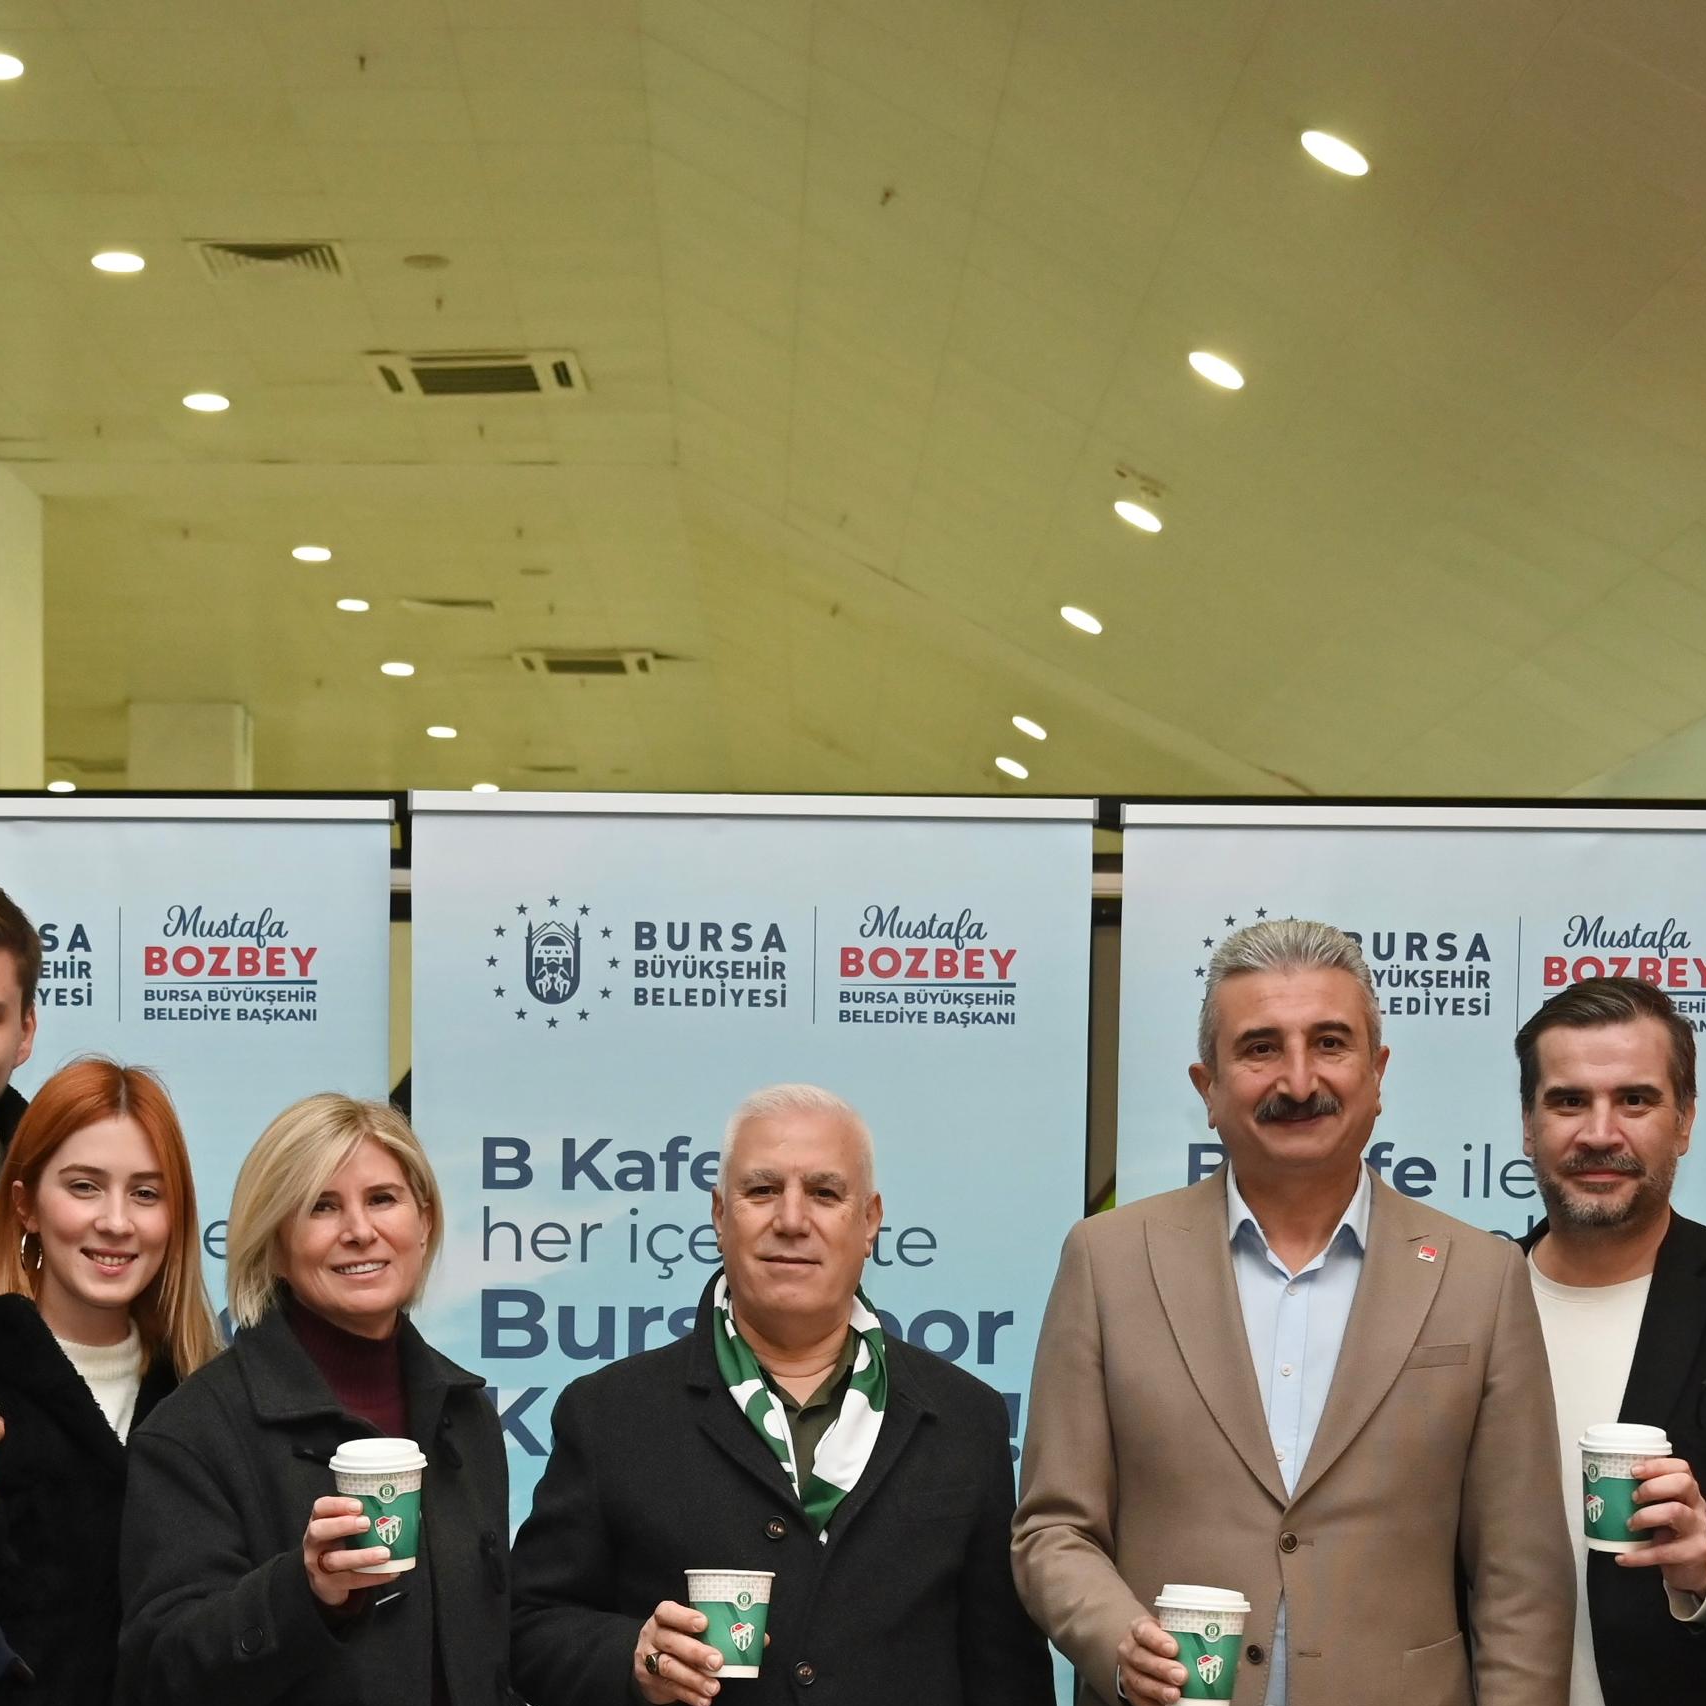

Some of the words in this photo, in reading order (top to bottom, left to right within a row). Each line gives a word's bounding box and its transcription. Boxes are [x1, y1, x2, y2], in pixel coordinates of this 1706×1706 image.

[162, 904, 290, 949] Mustafa
[634, 921, 787, 953] BURSA
[859, 904, 988, 950] Mustafa
[1563, 914, 1691, 960] Mustafa
[144, 945, 318, 977] BOZBEY
[634, 954, 787, 983] BÜYÜKŞEHİR
[840, 946, 1017, 980] BOZBEY
[1367, 964, 1491, 992] YÜKŞEHİR
[144, 989, 202, 1003] BURSA
[207, 986, 317, 1006] BÜYÜKŞEHİR
[634, 982, 787, 1008] BELEDİYESİ
[839, 990, 899, 1004] BURSA
[904, 989, 1016, 1009] BÜYÜKŞEHİR
[144, 1004, 231, 1021] BELEDİYE
[236, 1008, 317, 1025] BAŞKANI
[839, 1006, 928, 1024] BELEDİYE
[933, 1010, 1016, 1028] BAŞKANI
[482, 1136, 534, 1190] B
[562, 1135, 722, 1192] Kafe
[1463, 1143, 1537, 1199] ile
[483, 1206, 603, 1263] her
